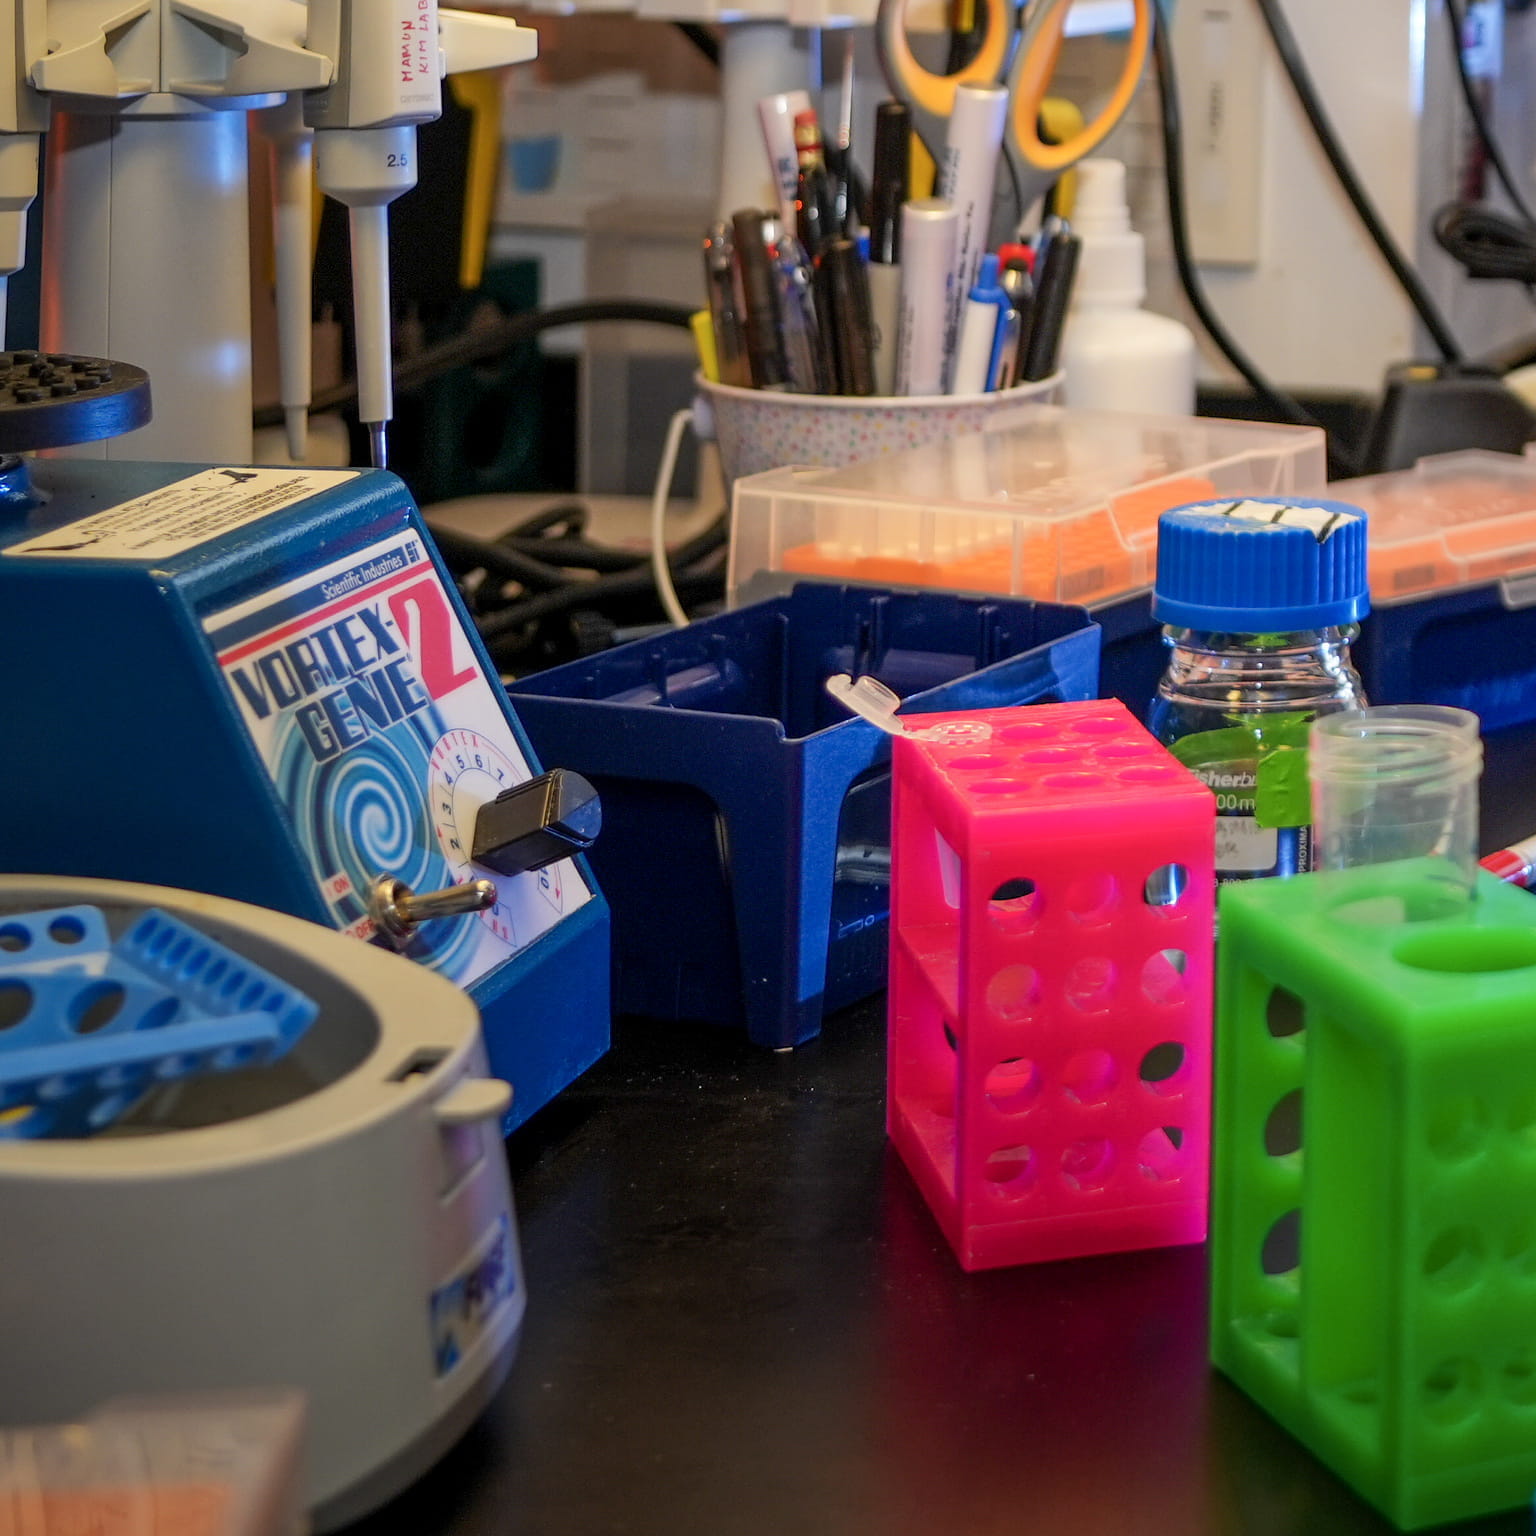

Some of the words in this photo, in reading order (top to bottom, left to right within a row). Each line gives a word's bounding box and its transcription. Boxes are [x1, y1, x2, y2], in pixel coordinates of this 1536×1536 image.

[418, 0, 430, 32] LAB
[418, 40, 430, 74] KIM
[387, 154, 408, 168] 2.5
[321, 571, 363, 601] Scientific
[362, 553, 403, 582] Industries
[387, 577, 479, 702] 2
[295, 654, 429, 765] GENIE
[455, 754, 465, 770] 5
[474, 753, 484, 769] 6
[443, 771, 454, 785] 4
[496, 768, 505, 781] 7
[441, 802, 452, 816] 3
[1216, 794, 1237, 809] 00
[1239, 798, 1257, 811] m
[450, 837, 460, 850] 2
[1297, 825, 1308, 873] PROXIMA
[333, 875, 350, 894] ON
